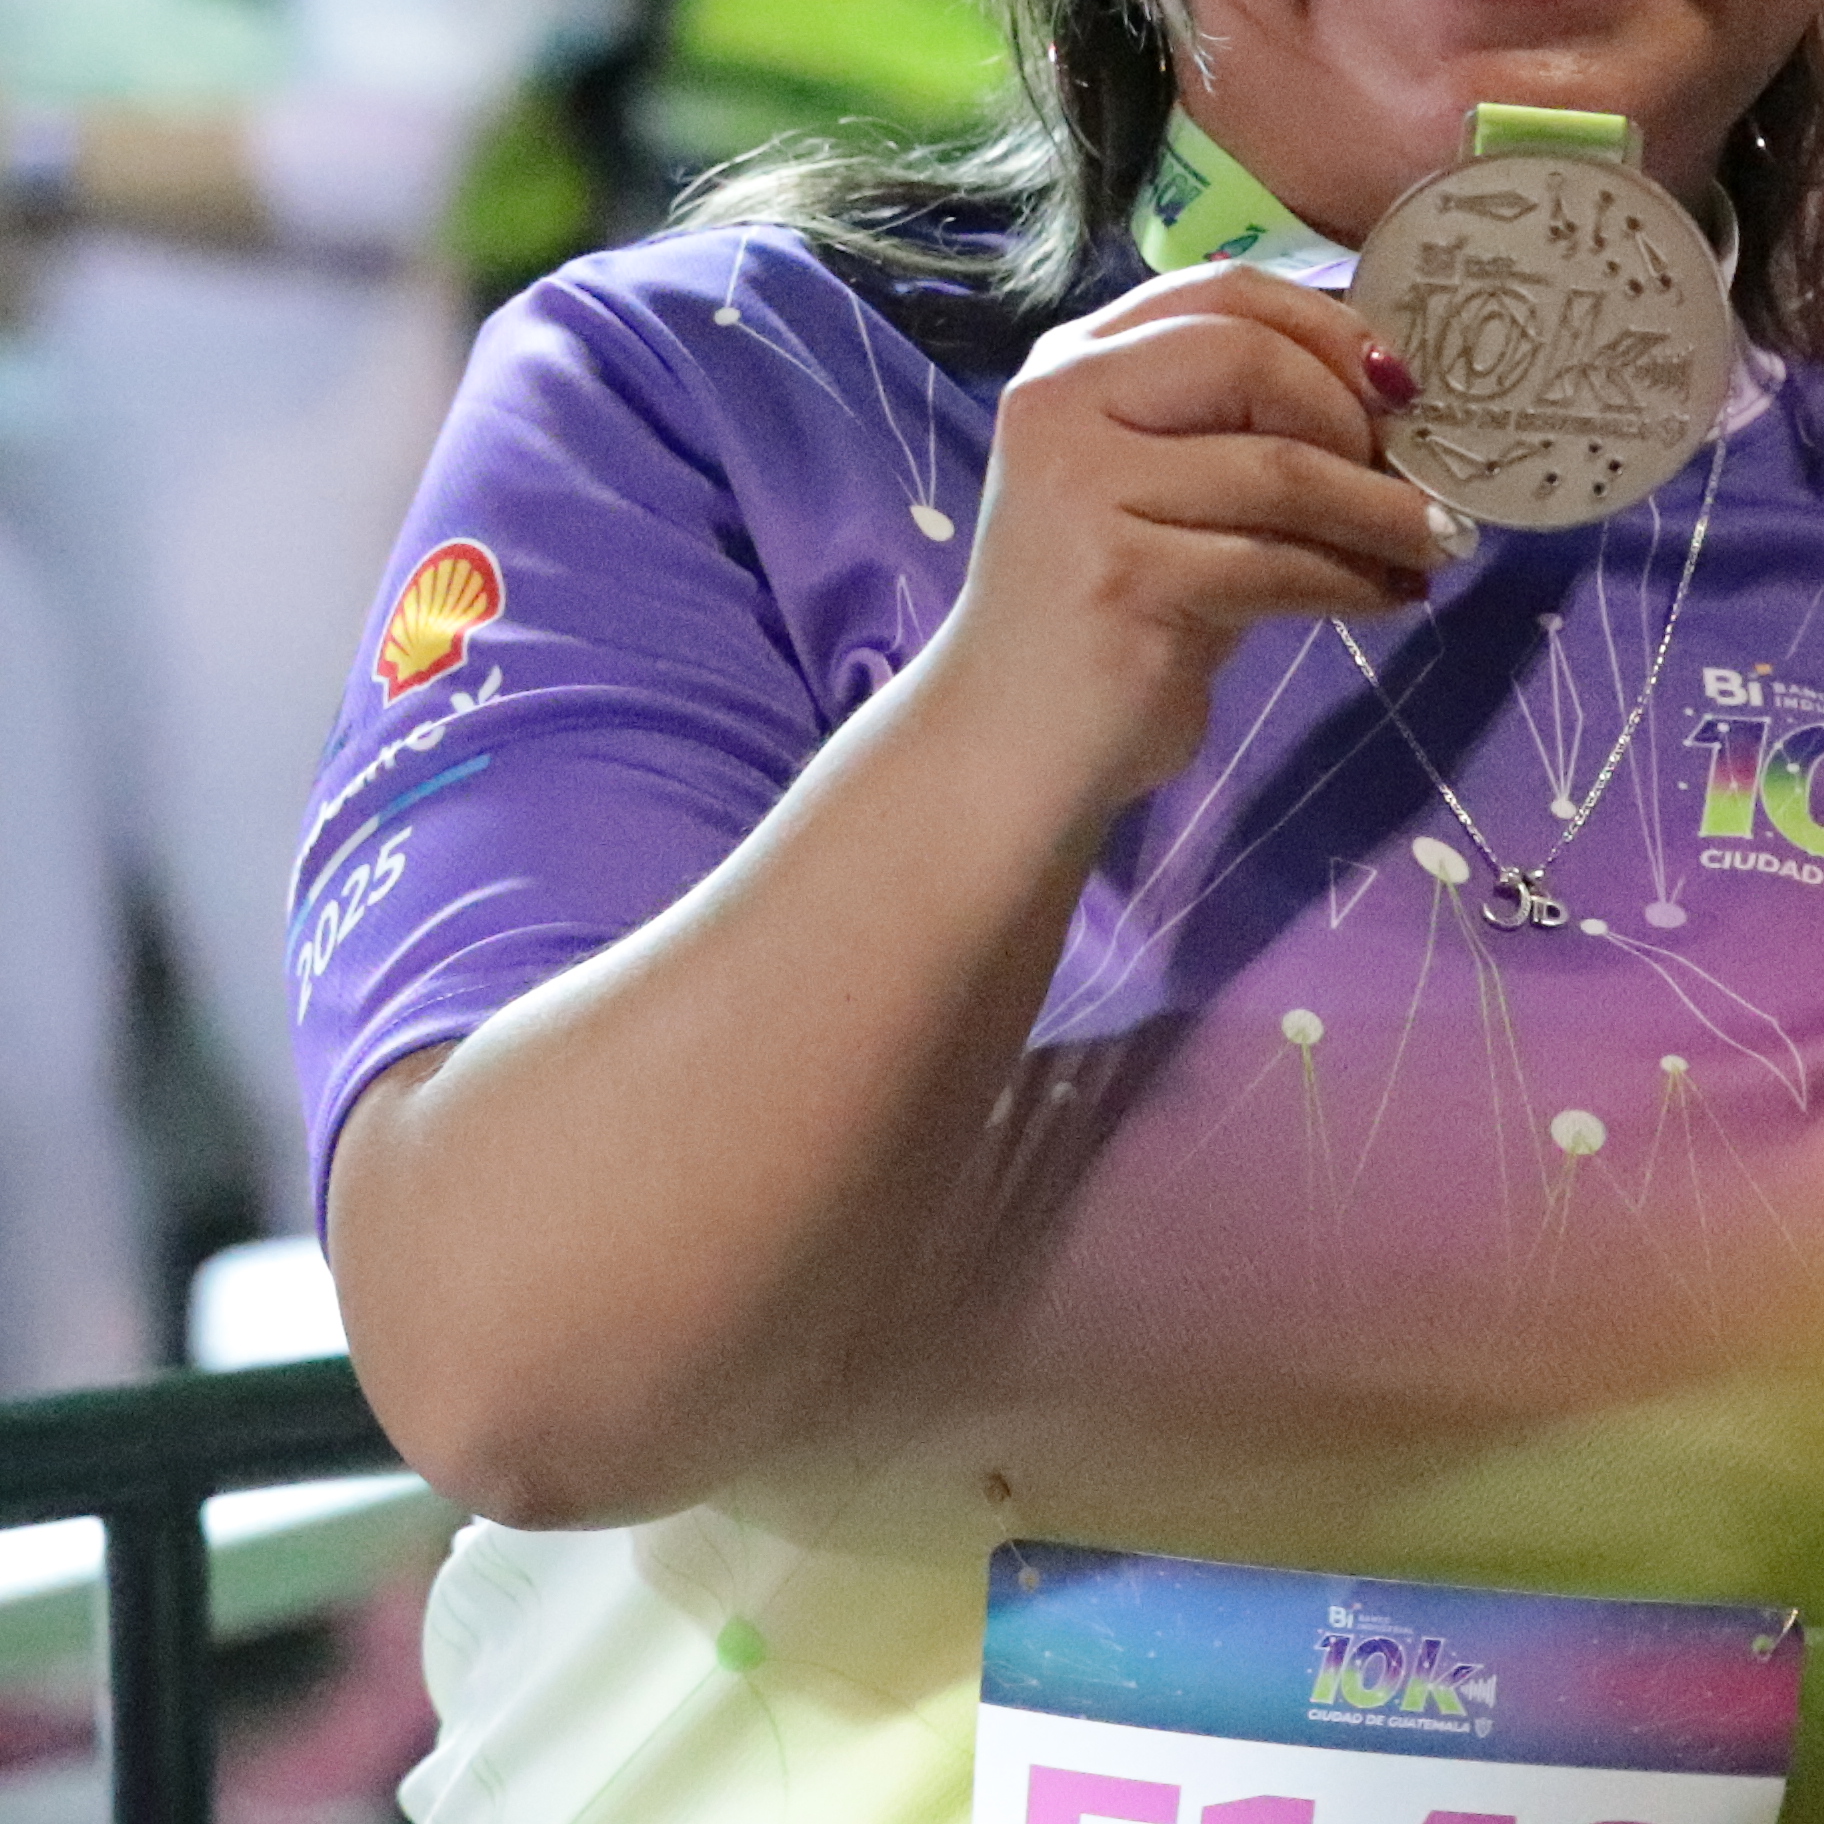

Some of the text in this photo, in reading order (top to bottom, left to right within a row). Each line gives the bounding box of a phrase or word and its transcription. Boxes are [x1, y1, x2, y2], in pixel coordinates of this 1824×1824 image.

[1703, 663, 1773, 708] Bi
[1699, 849, 1824, 886] CIUDAD
[296, 826, 413, 1026] 2025
[1307, 1709, 1471, 1734] CIUDAD DE GUATEMALA
